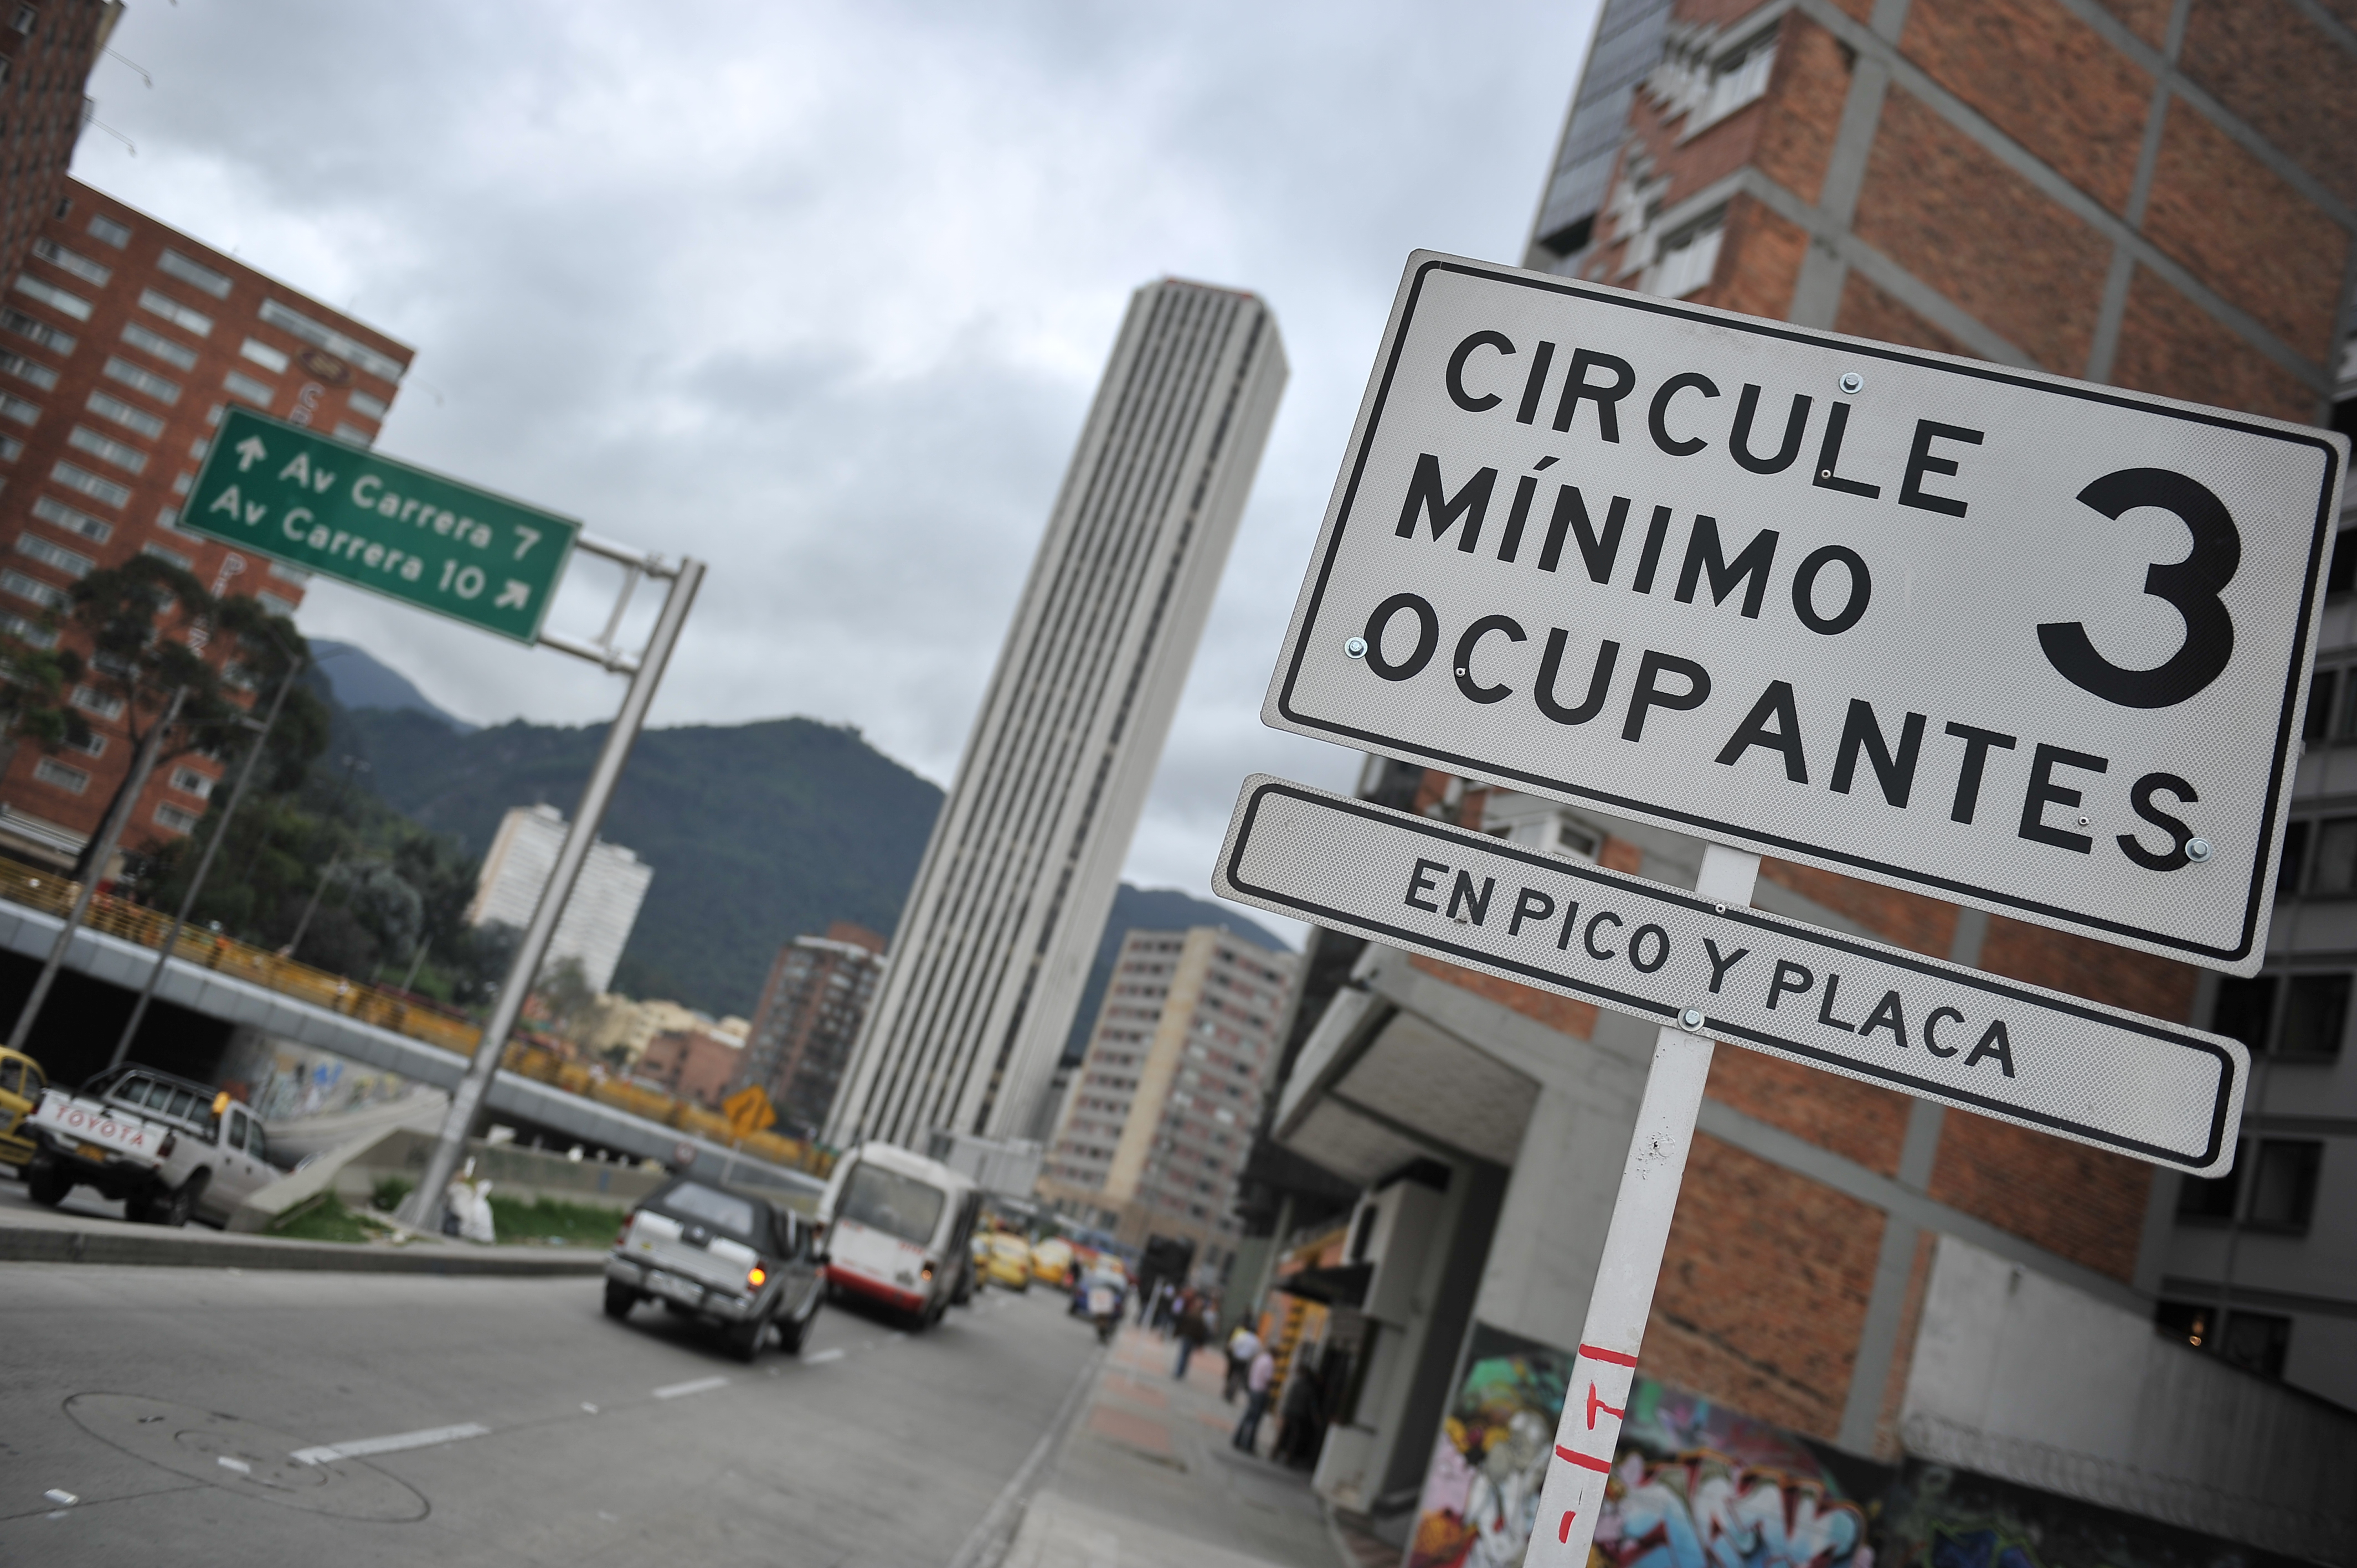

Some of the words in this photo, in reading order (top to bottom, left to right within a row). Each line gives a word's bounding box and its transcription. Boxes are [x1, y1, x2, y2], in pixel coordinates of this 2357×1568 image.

[278, 452, 337, 494] Av
[351, 474, 492, 549] Carrera
[513, 524, 542, 561] 7
[1445, 329, 1985, 518] CIRCULE
[209, 485, 268, 527] Av
[282, 508, 425, 583] Carrera
[438, 563, 487, 600] 10
[1394, 452, 1872, 636] MÍNIMO
[2036, 467, 2242, 709] 3
[1363, 592, 2199, 872] OCUPANTES
[1404, 857, 1496, 926] EN
[1508, 887, 1671, 973] PICO
[1701, 937, 1750, 994] Y
[1766, 958, 2016, 1079] PLACA
[56, 1105, 144, 1146] TOYOTA
